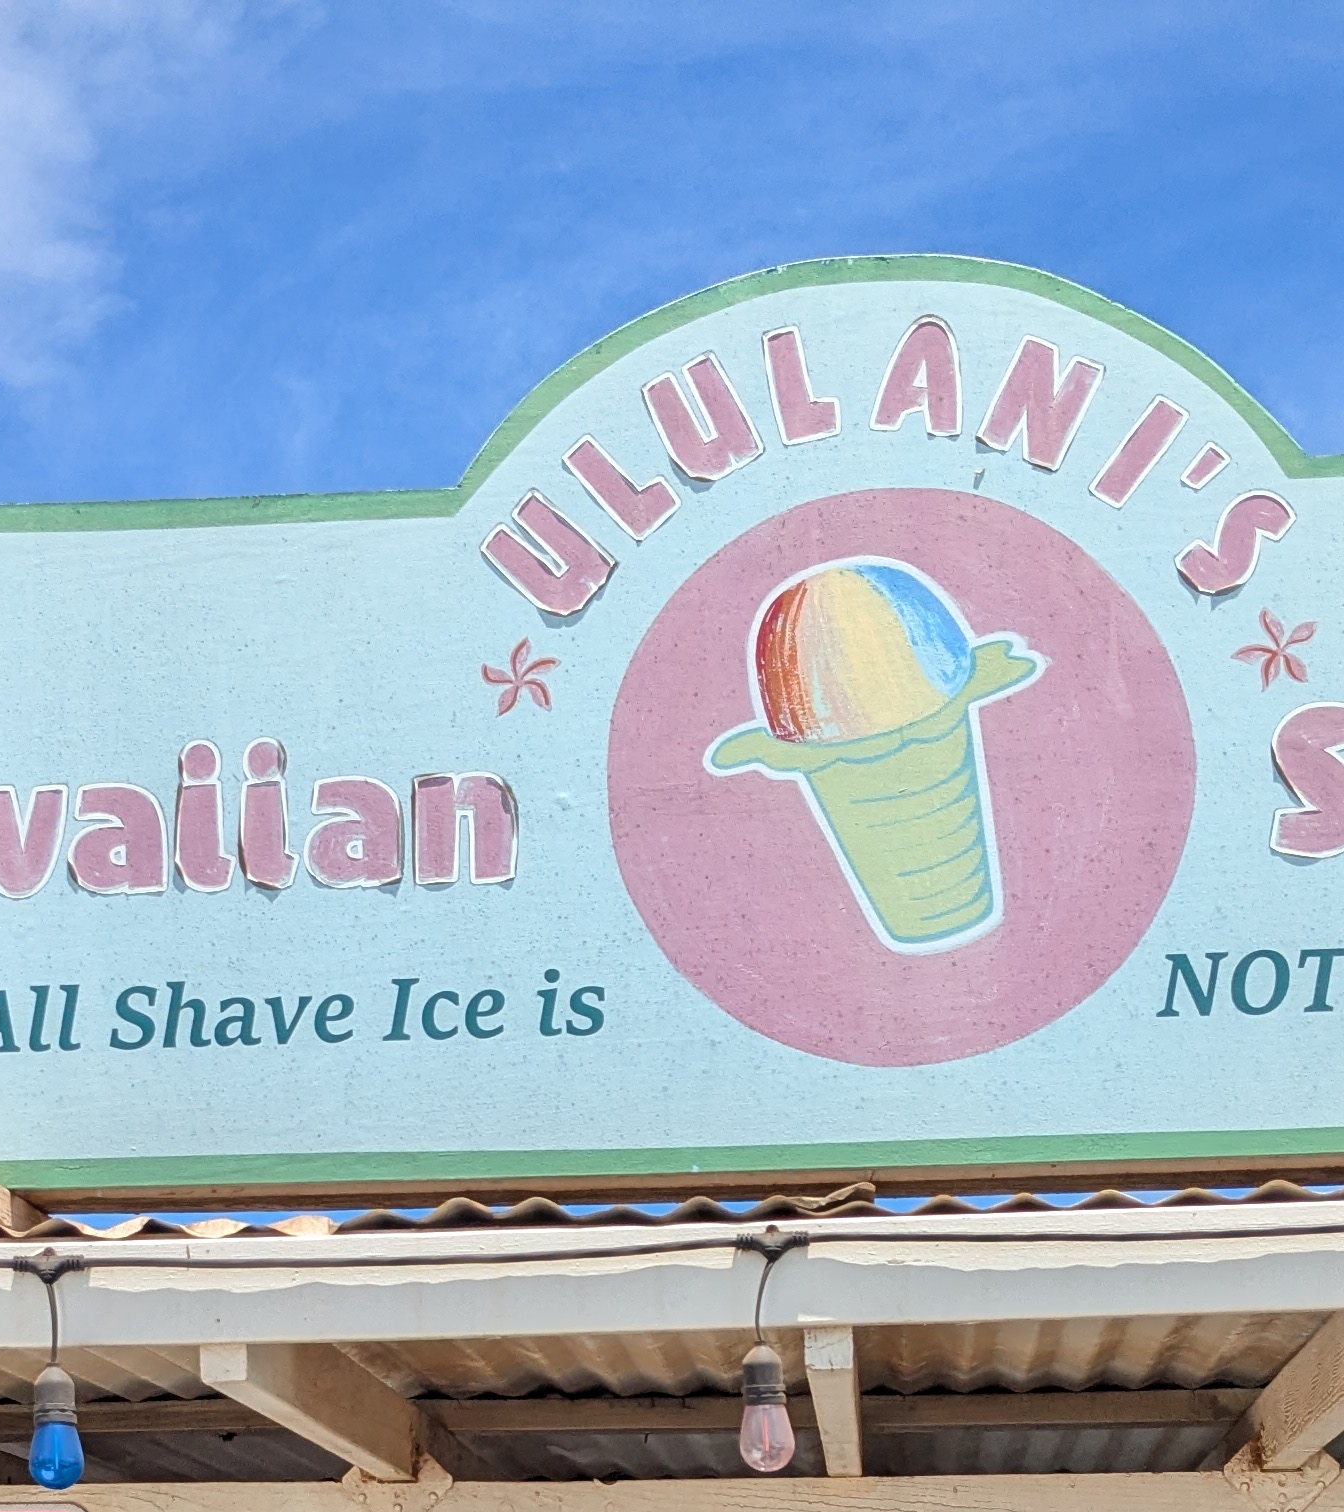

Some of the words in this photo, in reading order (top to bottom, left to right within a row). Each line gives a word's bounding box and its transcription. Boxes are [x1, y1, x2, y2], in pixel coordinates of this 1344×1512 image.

[481, 315, 1297, 615] ULULANI'S
[109, 981, 355, 1051] Shave
[383, 977, 505, 1041] Ice
[536, 968, 606, 1038] is
